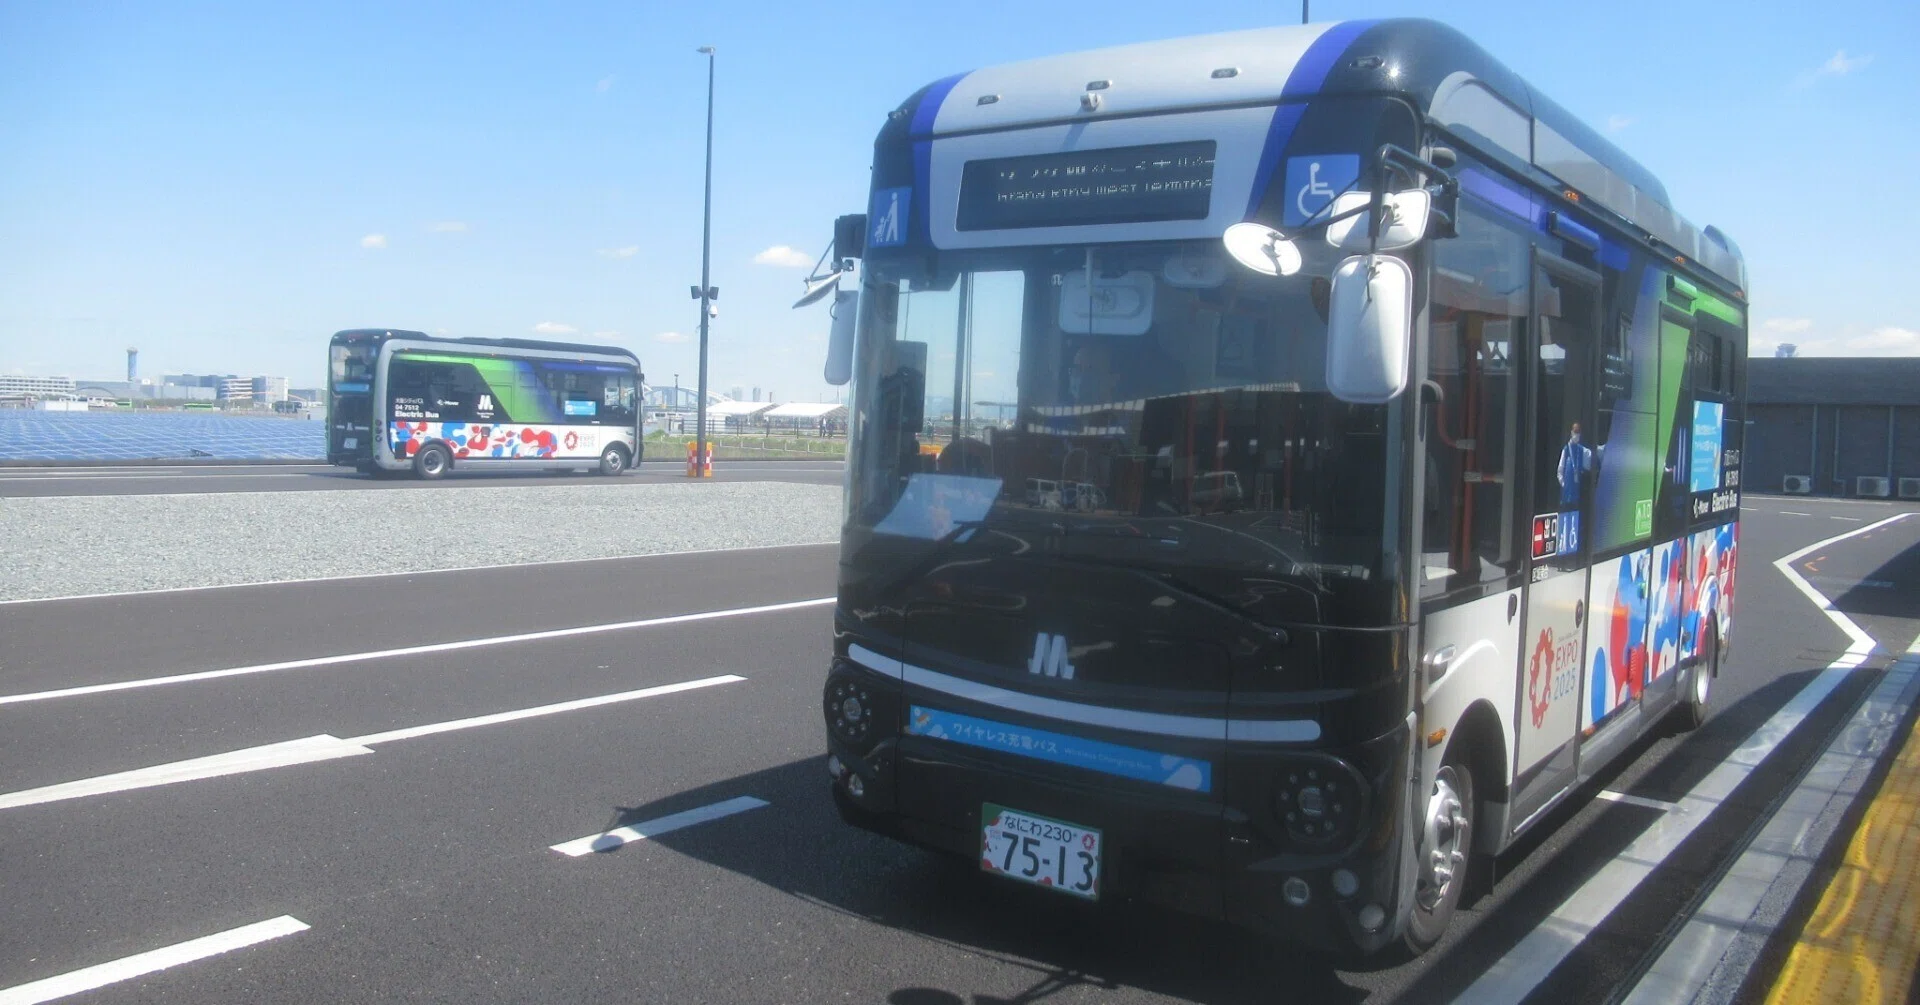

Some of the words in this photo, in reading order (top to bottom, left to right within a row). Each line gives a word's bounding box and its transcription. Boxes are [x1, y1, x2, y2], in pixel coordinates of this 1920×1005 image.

[394, 410, 424, 418] Electric
[1543, 518, 1557, 539] 出口
[1545, 540, 1556, 552] EXIT
[1556, 639, 1578, 672] EXPO
[1553, 667, 1576, 700] 2025
[953, 723, 1057, 754] ワイヤレス充電バス
[1002, 831, 1094, 891] 75-13
